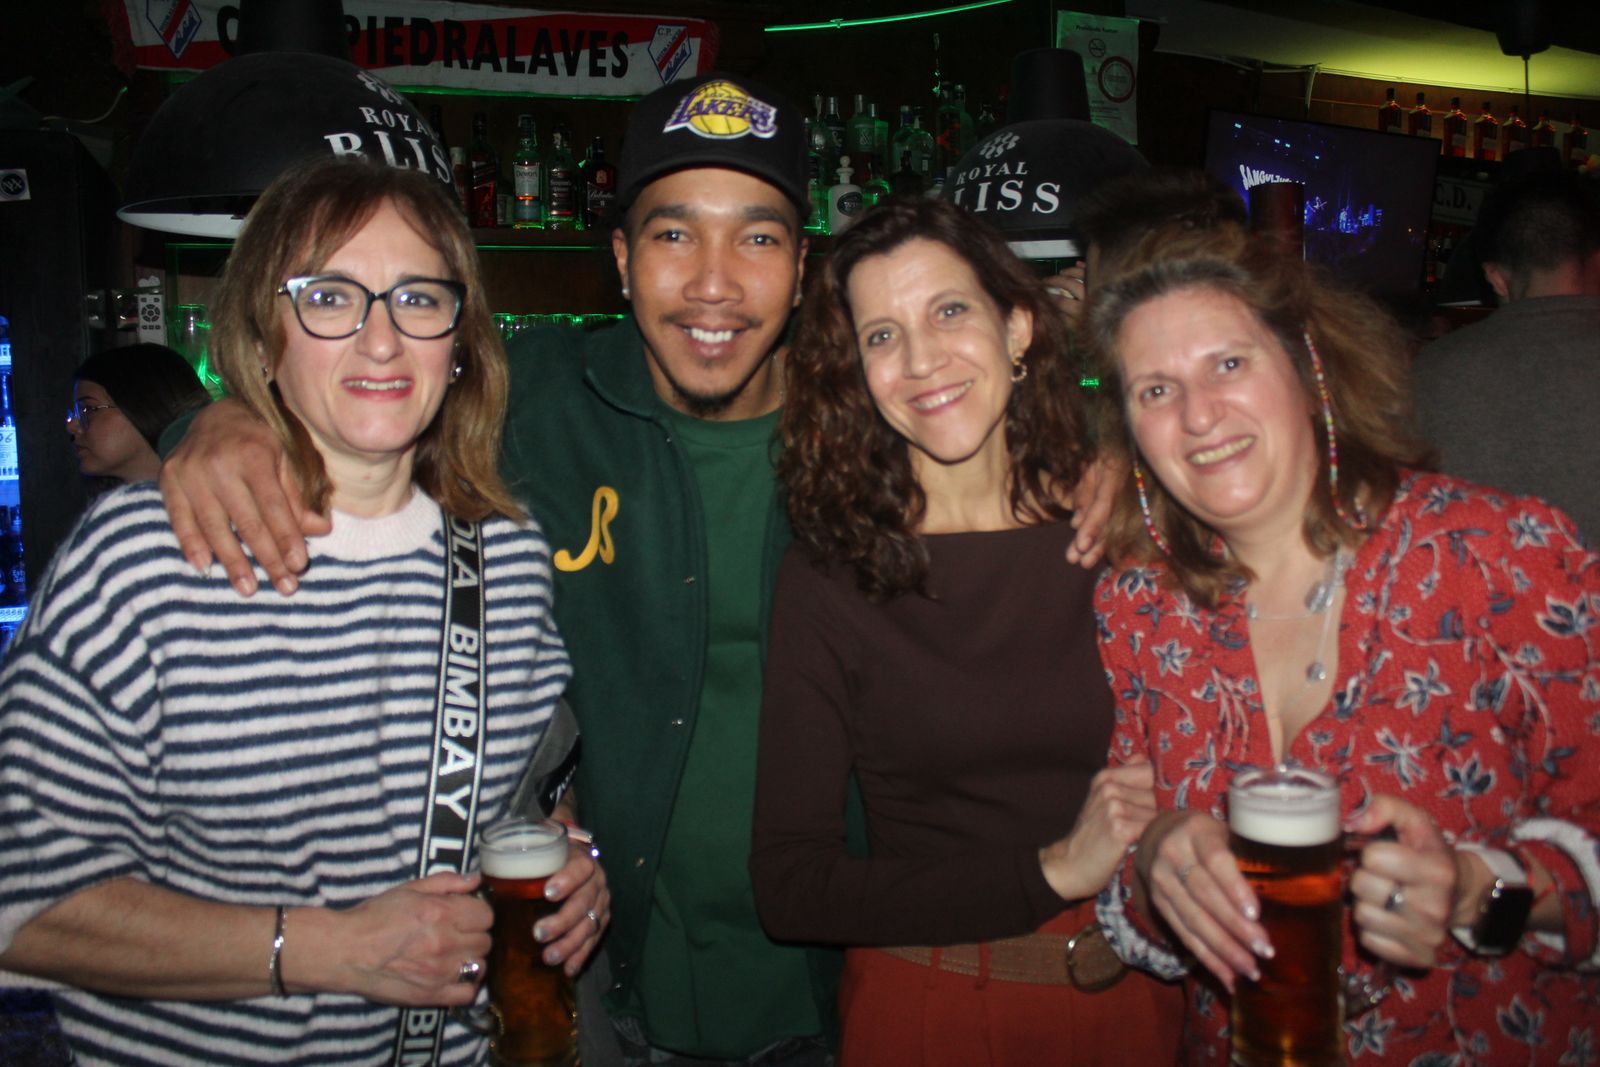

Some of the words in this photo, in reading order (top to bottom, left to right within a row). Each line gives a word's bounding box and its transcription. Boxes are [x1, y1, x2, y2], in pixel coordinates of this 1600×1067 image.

[664, 89, 778, 138] LAKERS
[955, 161, 1029, 186] ROYAL
[435, 623, 478, 821] BIMBAY
